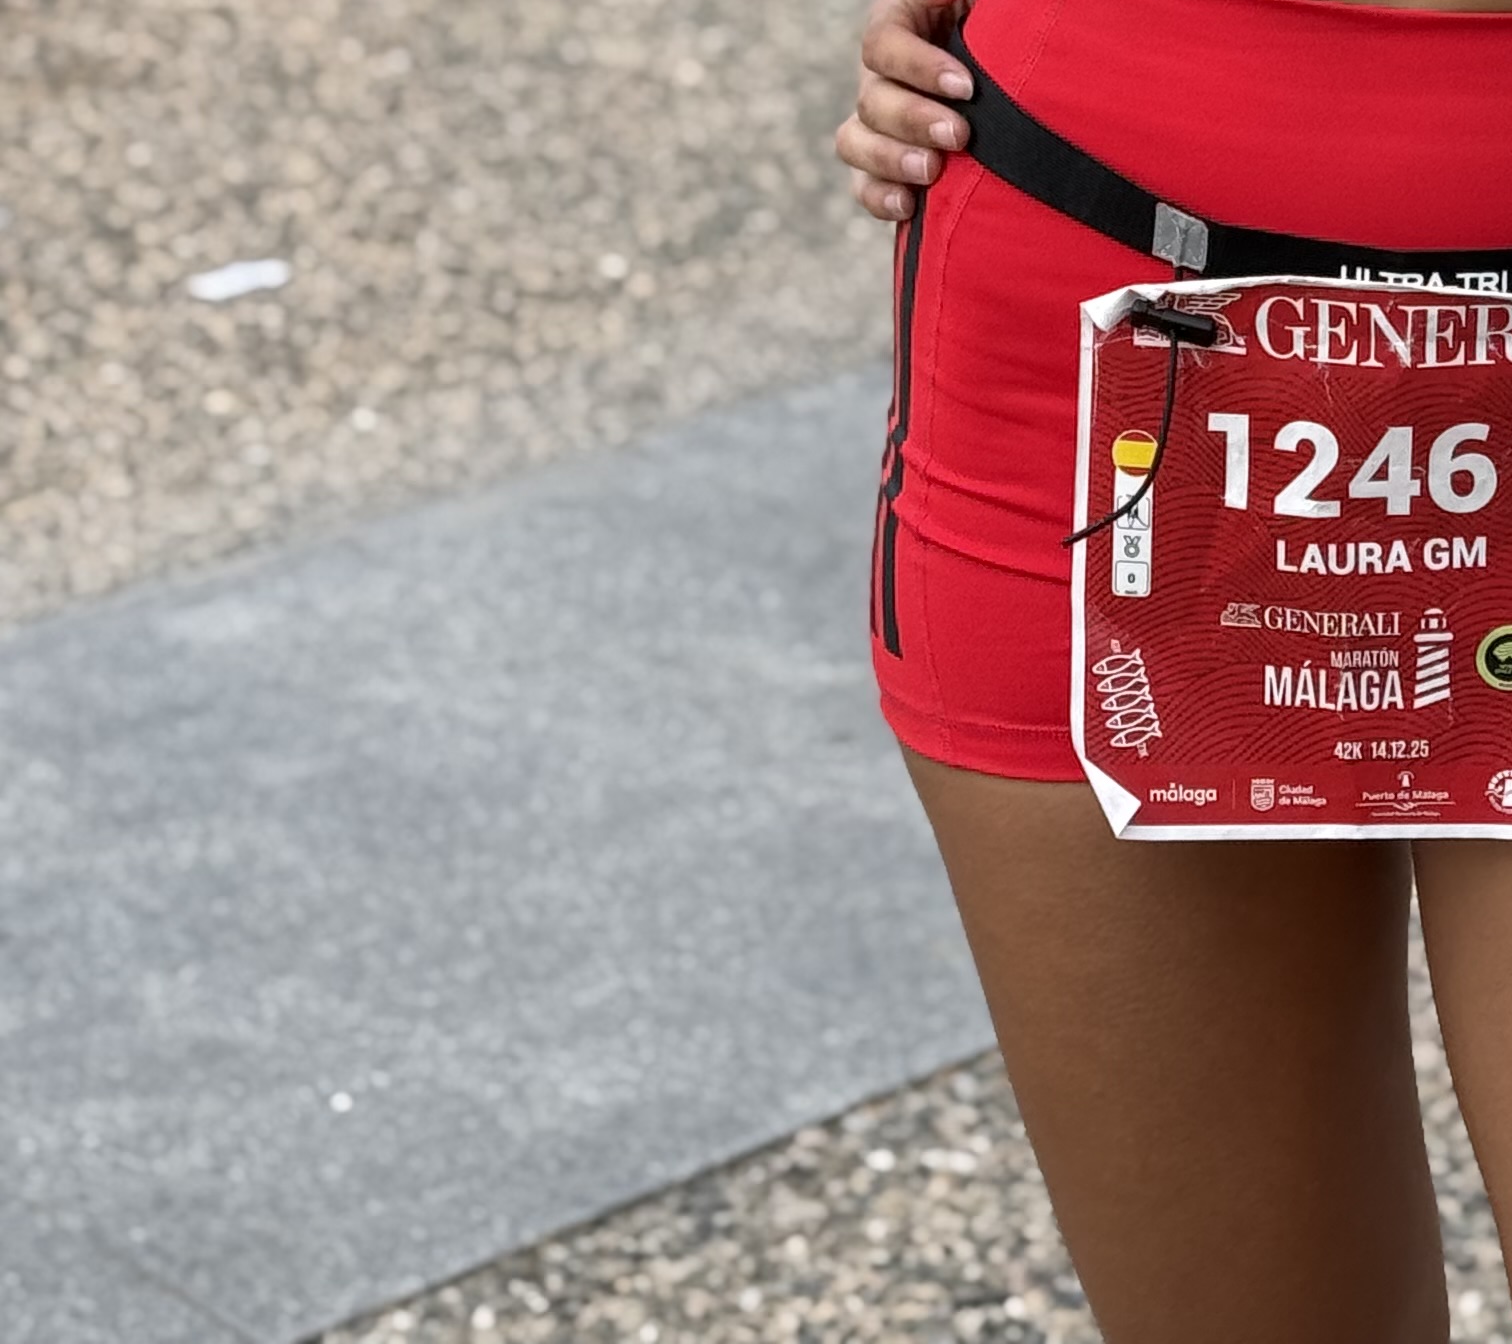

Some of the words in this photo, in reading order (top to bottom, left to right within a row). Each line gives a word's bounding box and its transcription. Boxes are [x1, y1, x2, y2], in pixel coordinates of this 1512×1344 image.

[1276, 539, 1414, 576] LAURA
[1422, 535, 1488, 572] GM
[1263, 605, 1402, 637] GENERALI
[1330, 647, 1399, 668] MARATÓN
[1263, 659, 1405, 712] MÁLAGA
[1333, 741, 1362, 760] 42K
[1370, 739, 1430, 758] 14.12.25
